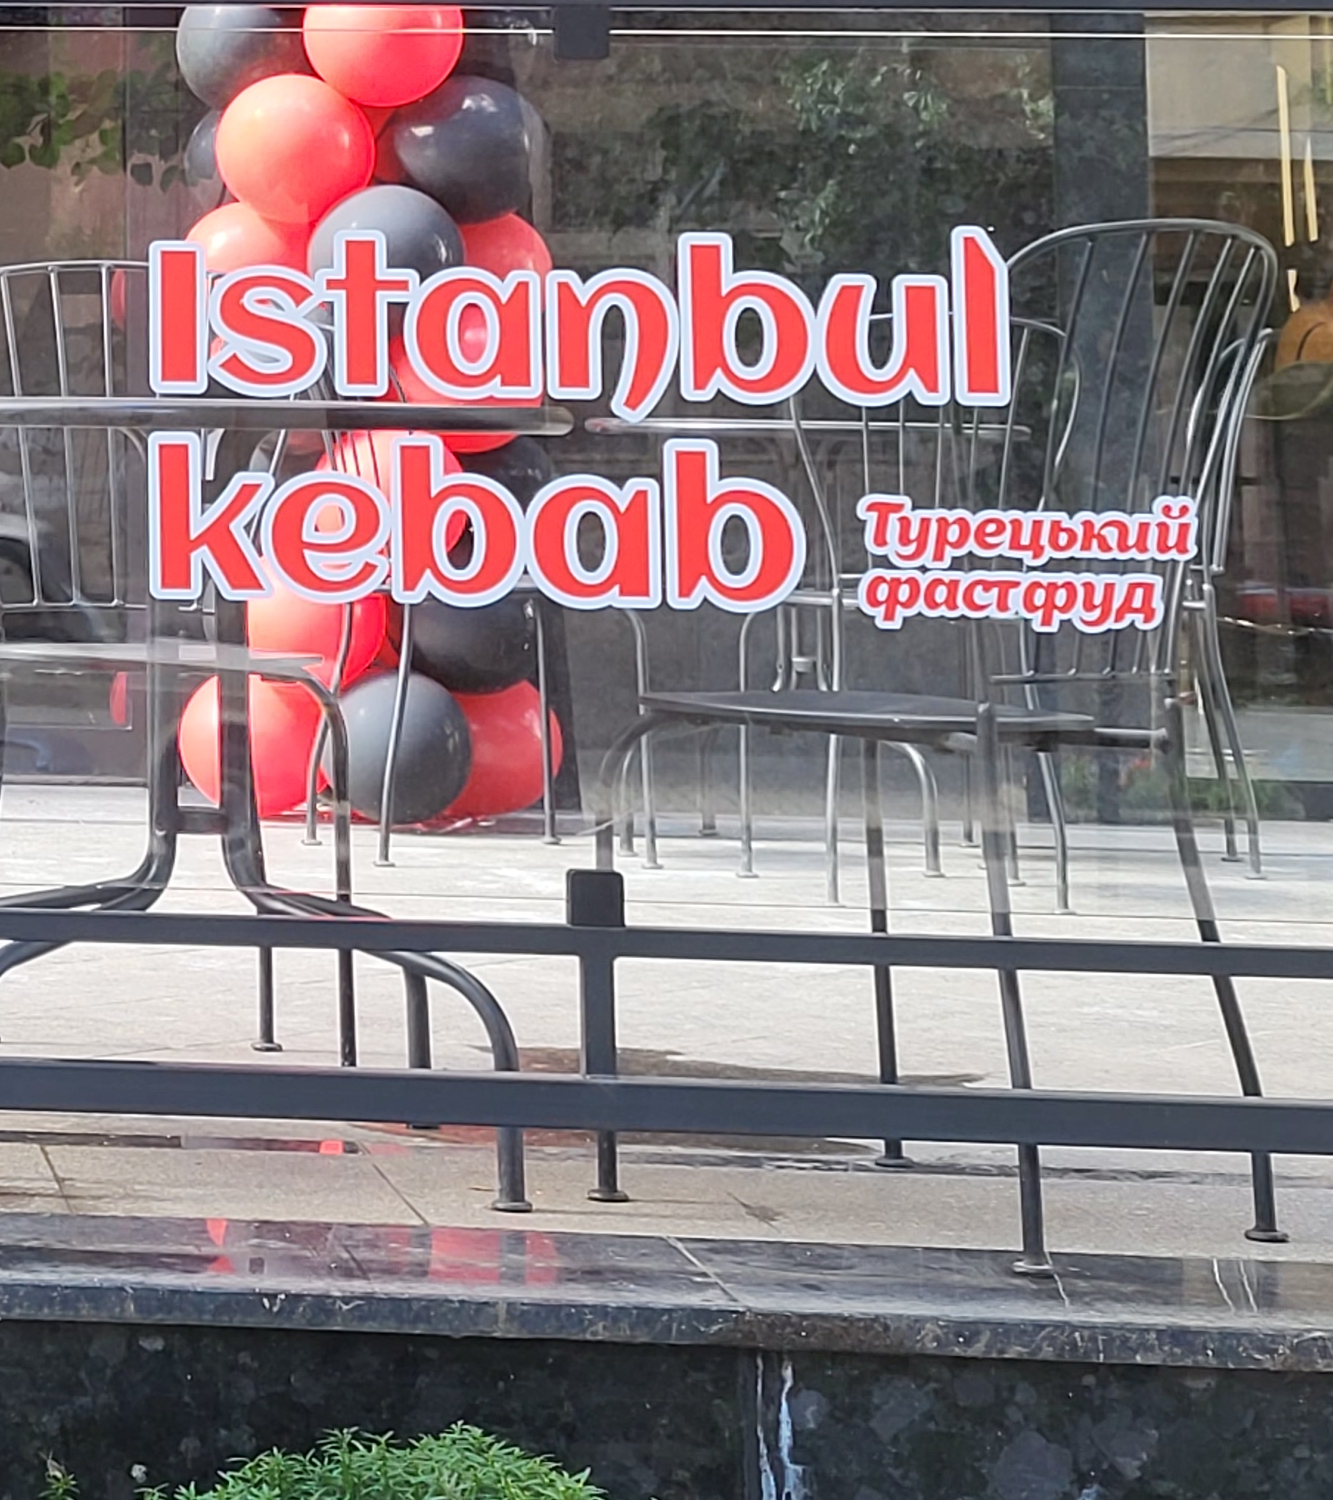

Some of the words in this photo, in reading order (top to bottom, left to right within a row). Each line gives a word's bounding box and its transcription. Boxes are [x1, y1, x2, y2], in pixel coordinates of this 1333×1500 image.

[153, 229, 1009, 417] Istanbul
[151, 436, 803, 607] kebab
[862, 498, 1194, 563] Турецький
[863, 572, 1161, 629] фастфуд
